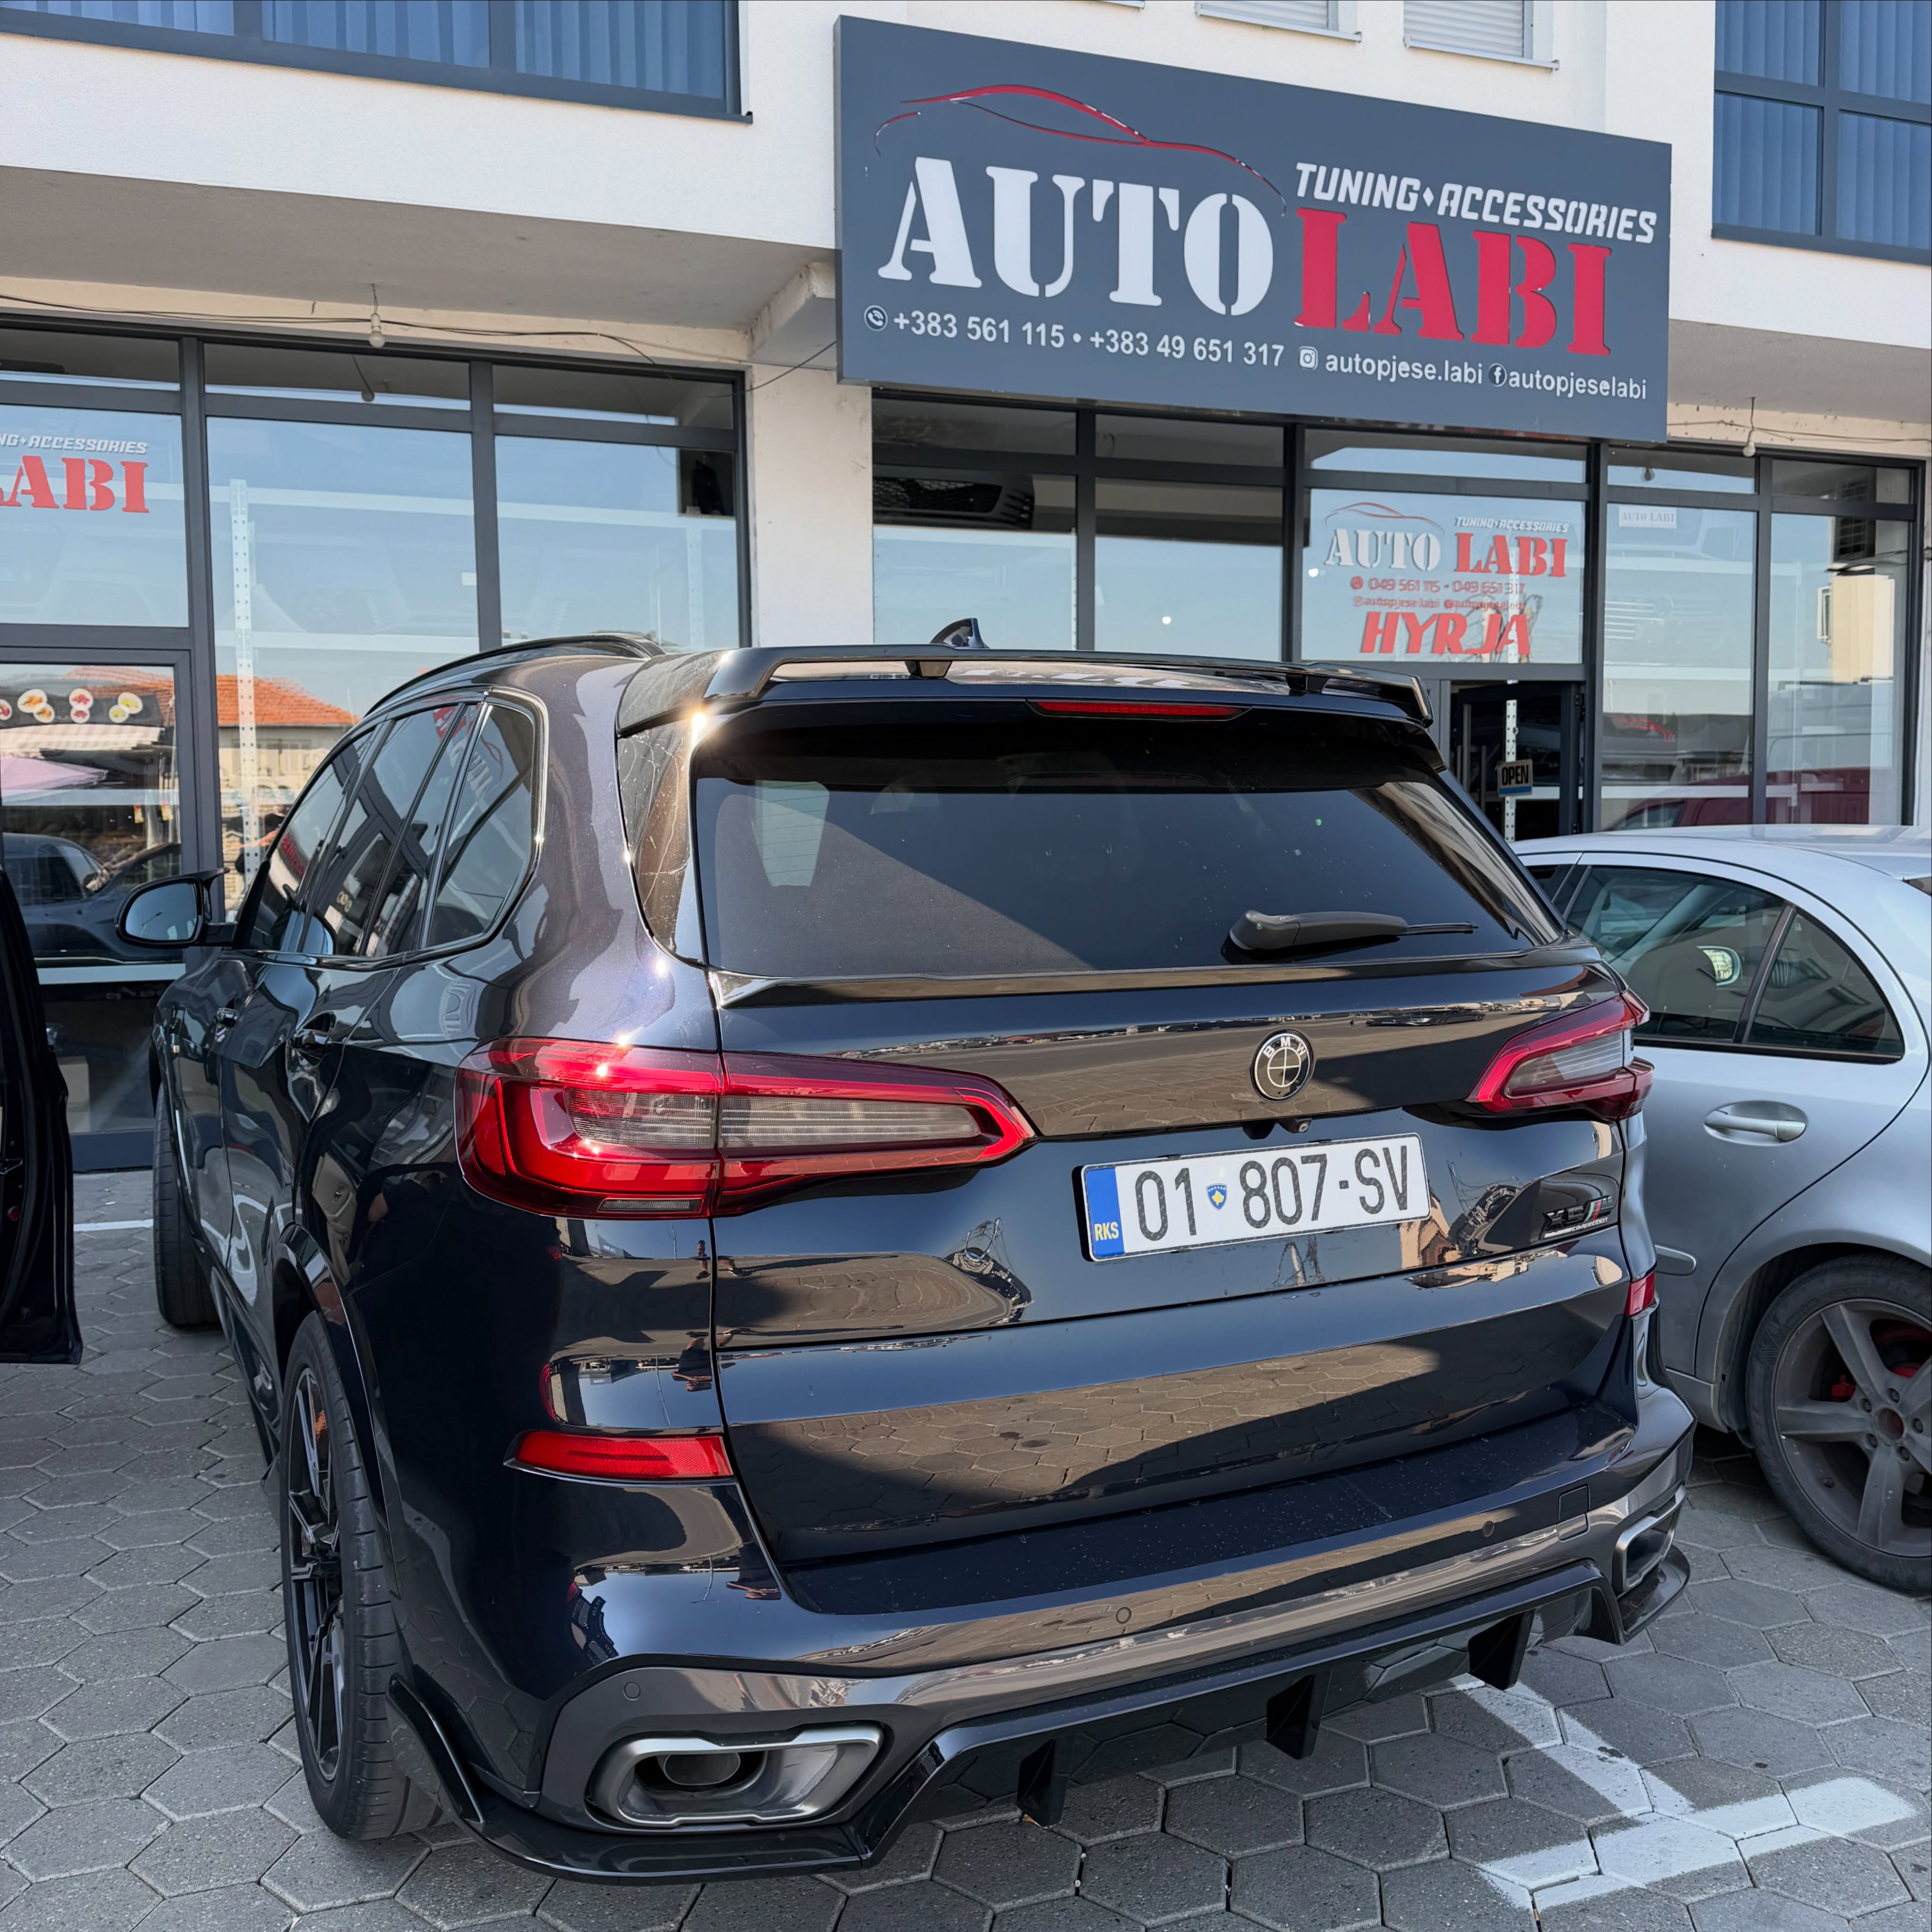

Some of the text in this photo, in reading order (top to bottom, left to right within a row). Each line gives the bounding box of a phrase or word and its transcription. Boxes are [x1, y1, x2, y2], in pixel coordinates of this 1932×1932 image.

[1296, 162, 1657, 244] TUNING ACCESSORIES
[878, 157, 1273, 316] AUTO
[1294, 207, 1612, 356] LABI
[894, 310, 1284, 366] +383 561 115 +383 49 651 317
[1325, 353, 1482, 383] autopjese.labi
[1509, 369, 1647, 400] autopjeselabi
[28, 435, 147, 455] ACCESSORIES
[1324, 528, 1441, 572] AUTO
[1454, 533, 1568, 577] LABI
[1399, 579, 1420, 591] 561
[1359, 611, 1530, 655] HYRJA
[1502, 765, 1529, 785] OPEN
[1263, 1037, 1306, 1058] BMW
[1135, 1167, 1197, 1241] 01
[1094, 1222, 1119, 1241] RKS
